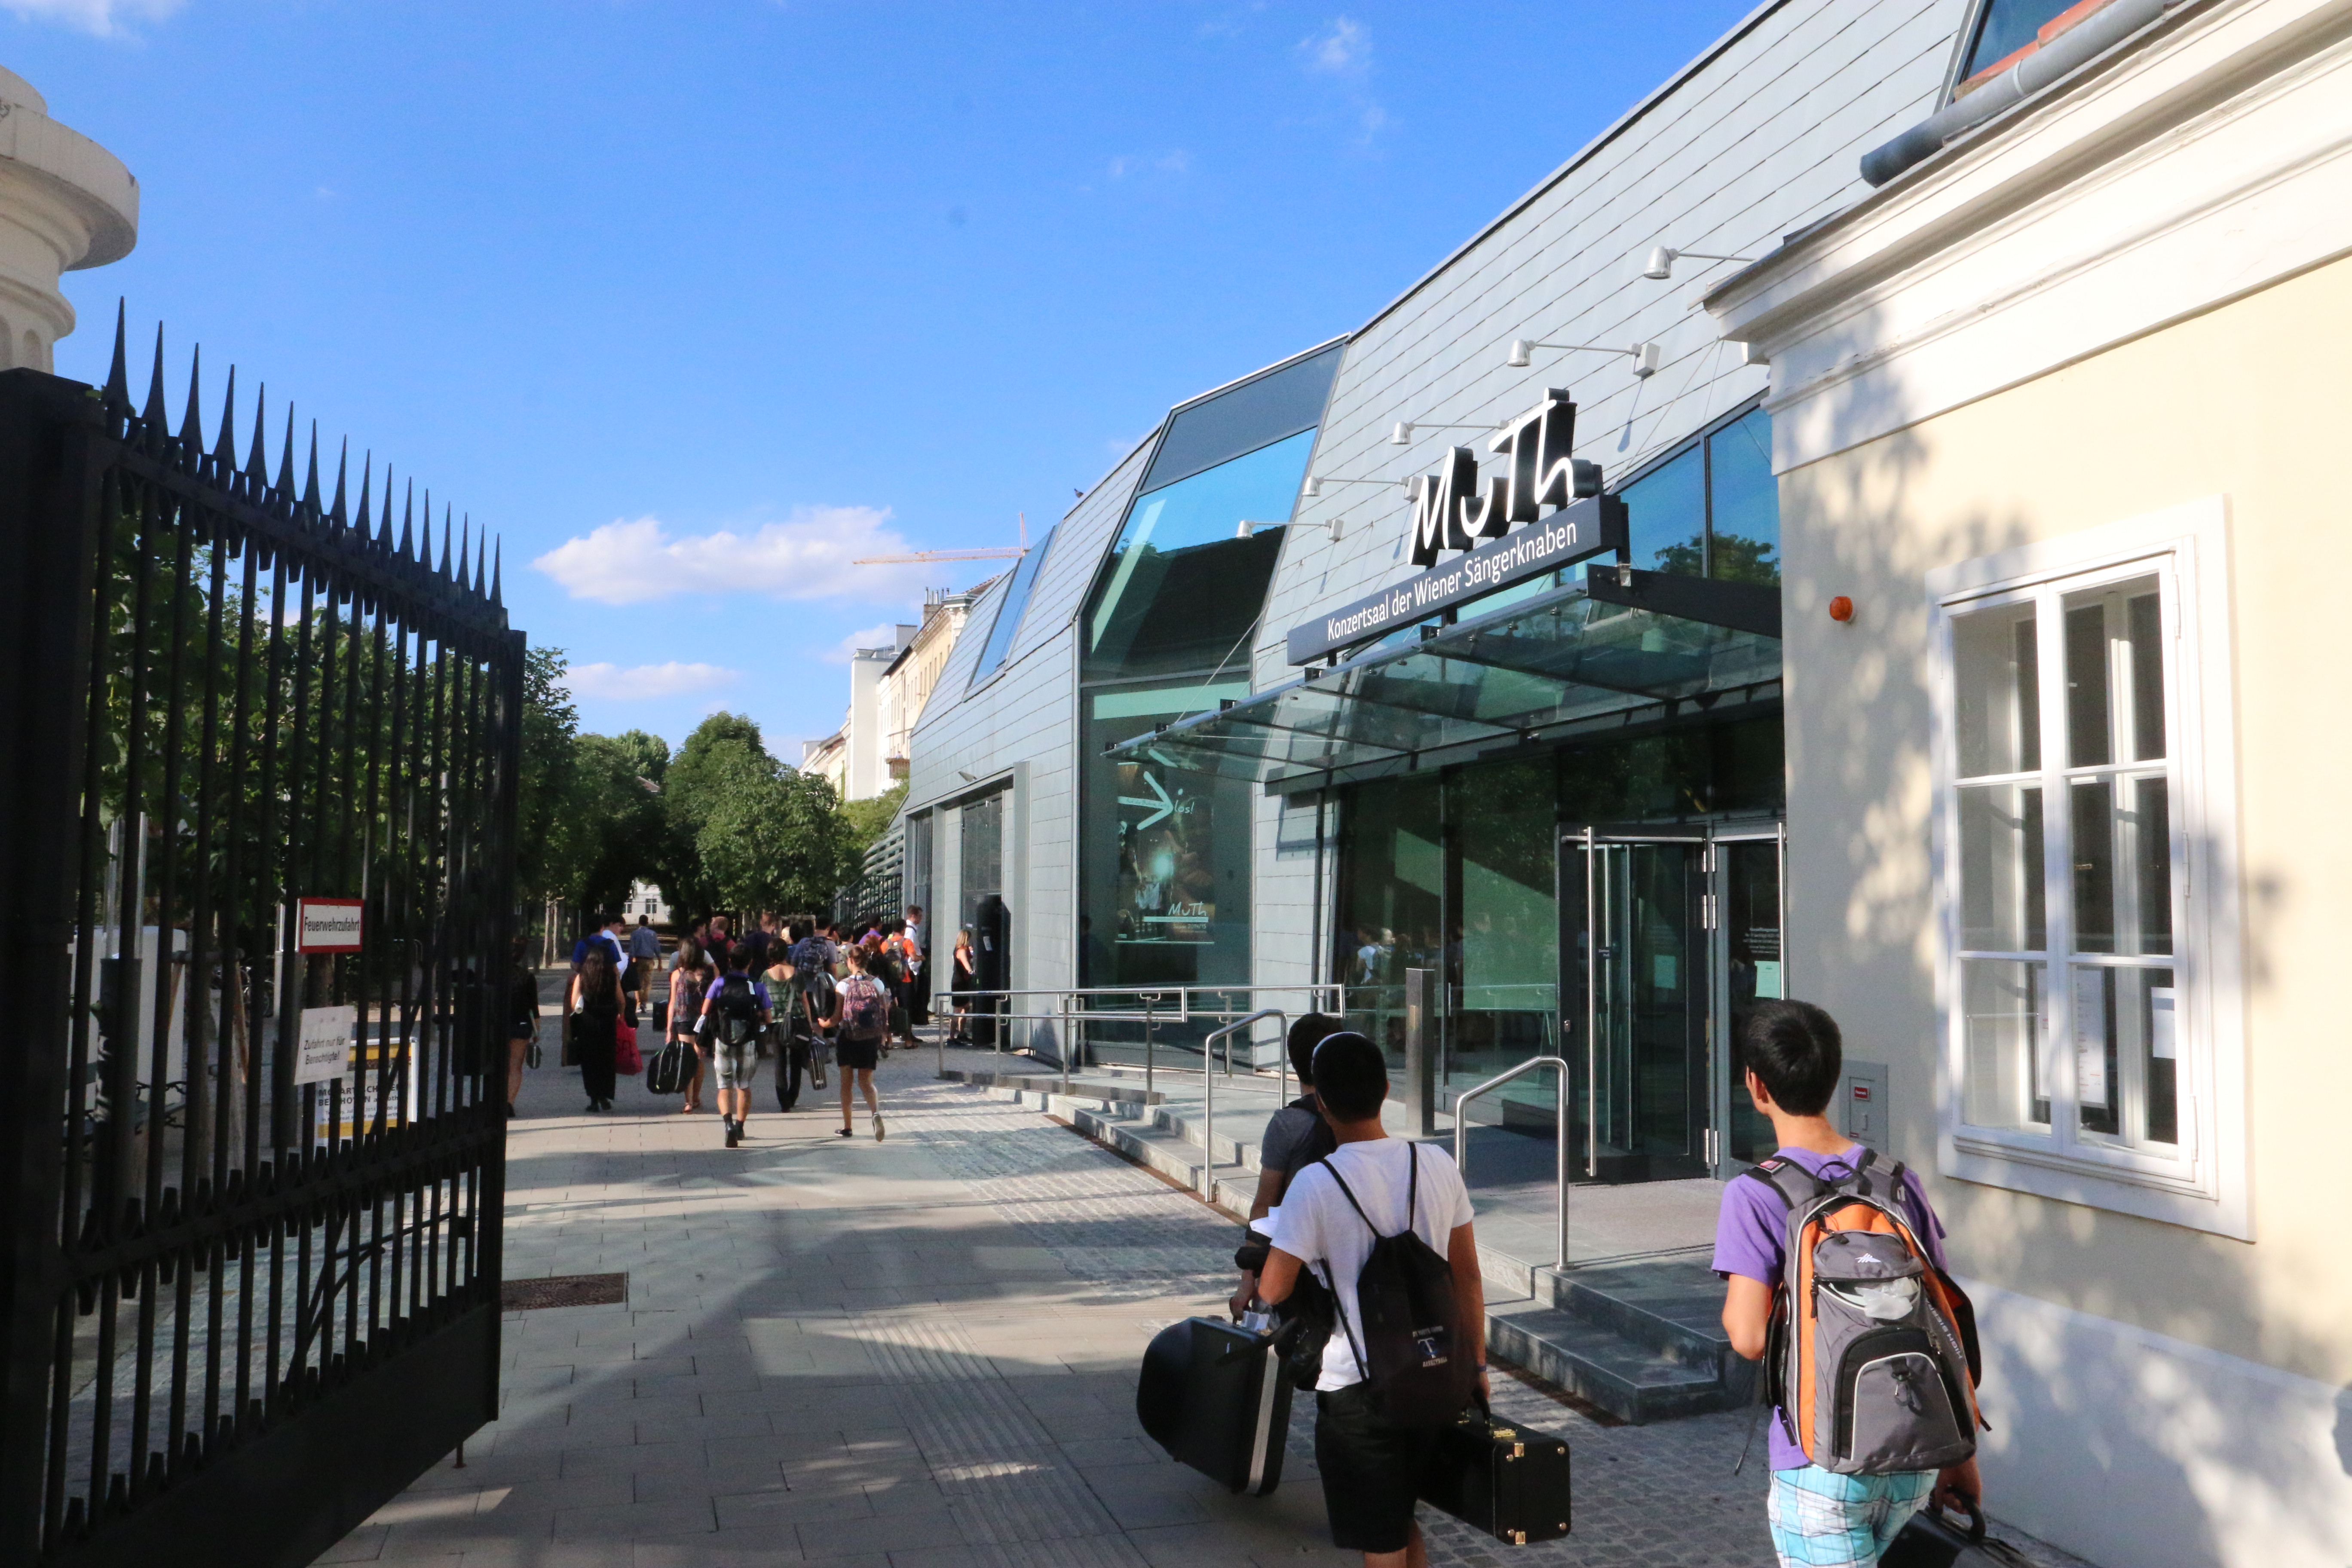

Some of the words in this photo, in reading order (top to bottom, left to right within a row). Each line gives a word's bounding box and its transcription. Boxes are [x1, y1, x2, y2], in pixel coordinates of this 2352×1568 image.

[1328, 594, 1389, 641] Konzertsaal
[1392, 589, 1412, 616] der
[1414, 571, 1461, 606] Wiener
[1465, 522, 1577, 587] Sängerknaben
[1174, 799, 1194, 815] los!
[1168, 901, 1207, 916] MuTh
[304, 916, 360, 931] Feuerwehrzufahrt
[304, 1038, 325, 1050] Zufahrt
[325, 1039, 336, 1047] nur
[337, 1035, 345, 1046] für
[306, 1050, 340, 1064] Berechtigte!
[1946, 1333, 1963, 1359] HIGH
